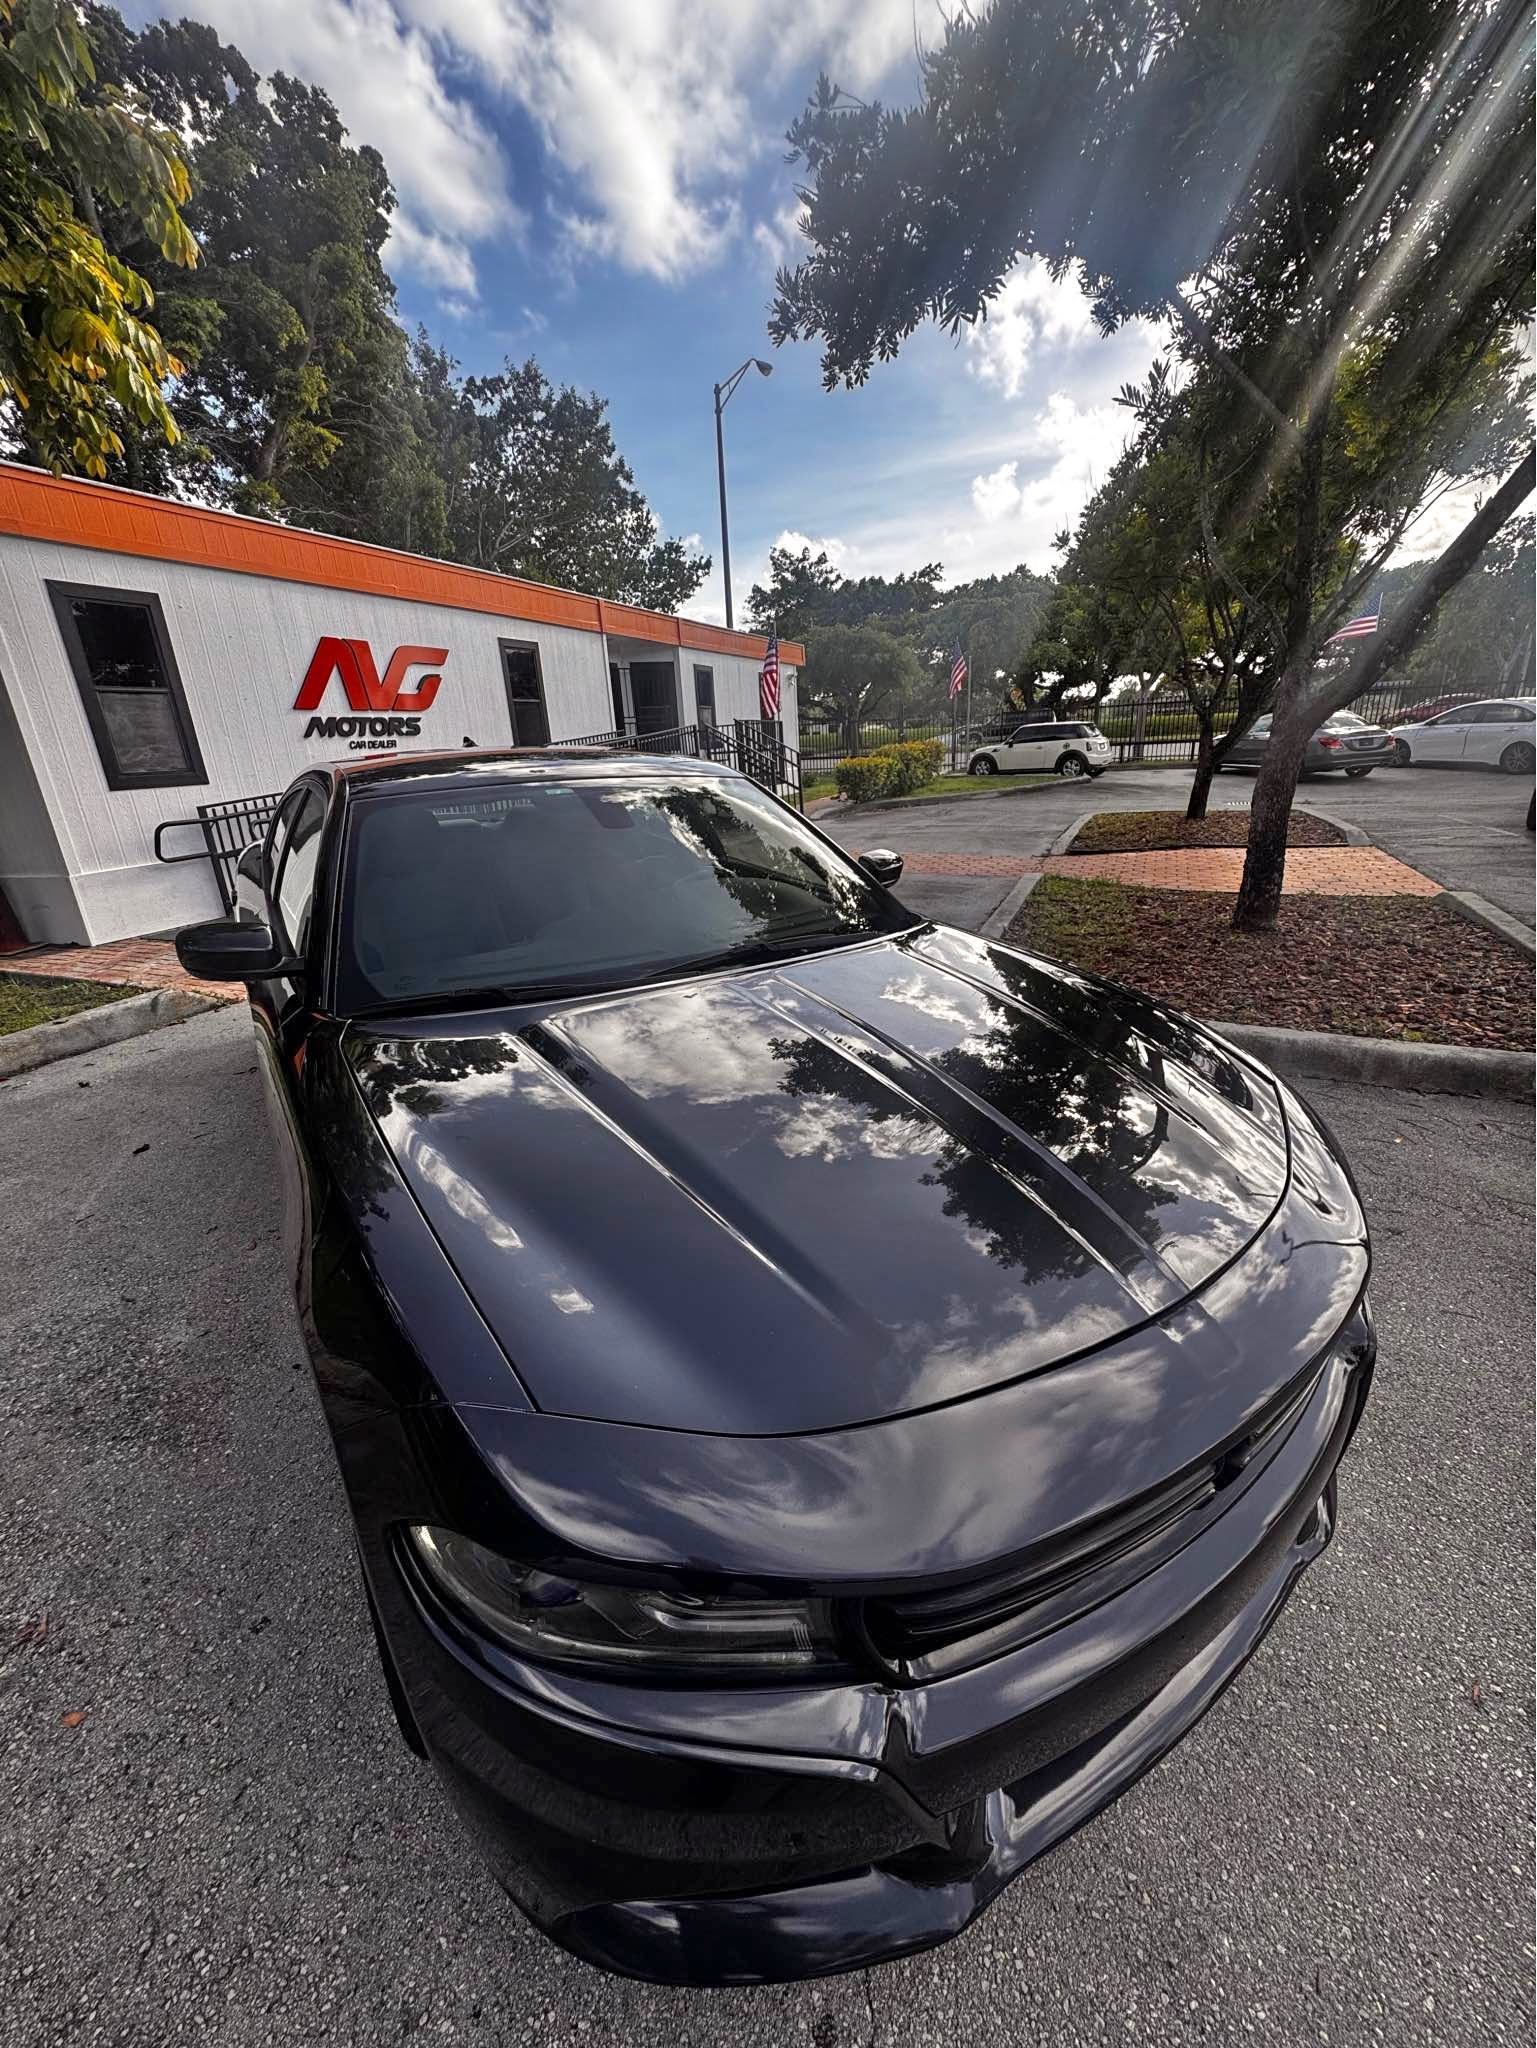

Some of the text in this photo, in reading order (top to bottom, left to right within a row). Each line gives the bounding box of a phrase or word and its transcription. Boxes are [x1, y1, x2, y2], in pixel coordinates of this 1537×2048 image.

[304, 717, 421, 738] MOTORS
[349, 740, 397, 750] CAR DEALER
